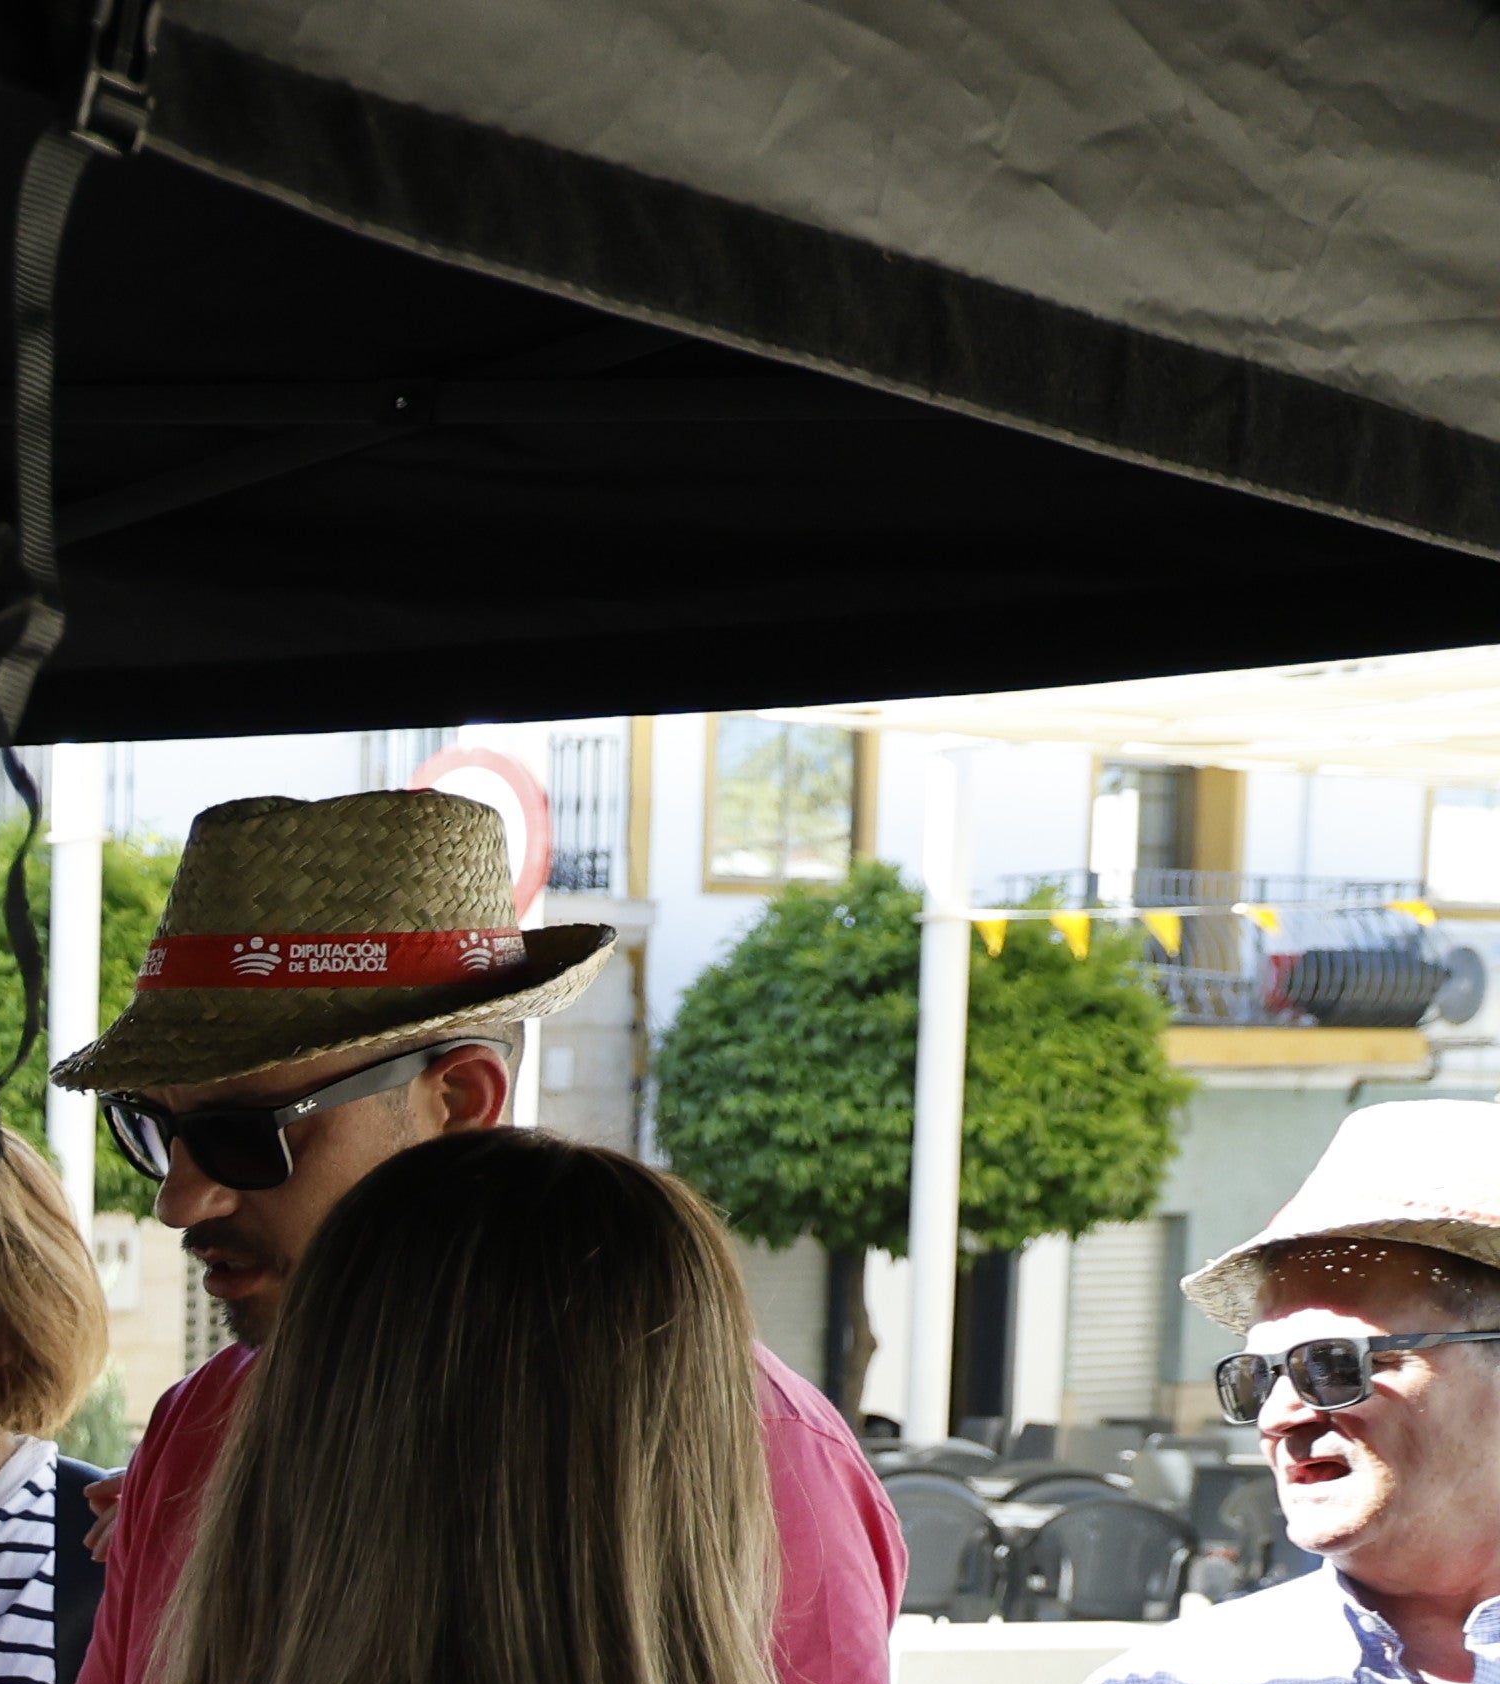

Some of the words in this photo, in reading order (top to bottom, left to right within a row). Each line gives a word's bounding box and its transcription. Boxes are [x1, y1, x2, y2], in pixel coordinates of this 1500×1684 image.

[289, 939, 387, 958] DIPUTACIÓN
[288, 961, 305, 972] DE
[309, 957, 388, 972] BADAJOZ
